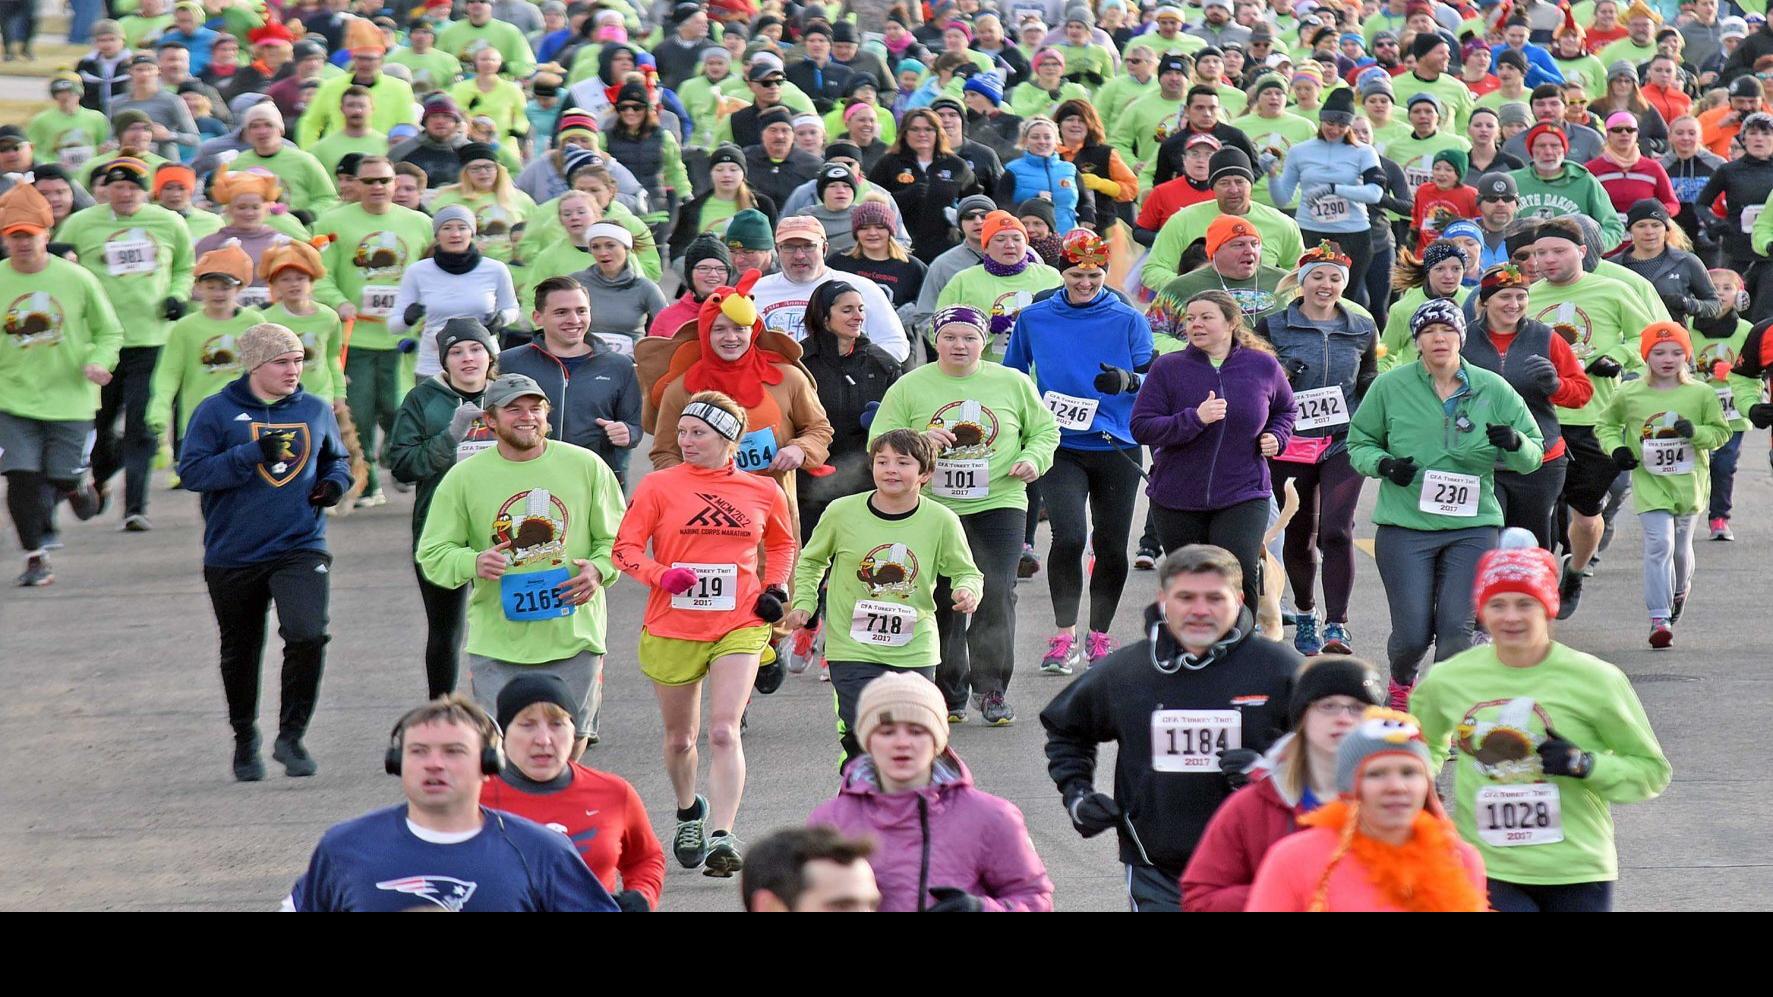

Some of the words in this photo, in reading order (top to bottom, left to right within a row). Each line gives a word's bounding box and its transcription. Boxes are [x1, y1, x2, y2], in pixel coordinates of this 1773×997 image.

[1316, 201, 1345, 217] 1290
[1050, 400, 1089, 422] 1246
[1298, 397, 1341, 420] 1242
[1313, 416, 1330, 425] 2017
[737, 446, 772, 468] 064
[1655, 447, 1684, 466] 394
[944, 471, 976, 488] 101
[1434, 484, 1468, 505] 230
[680, 528, 700, 536] MARINE
[513, 587, 564, 613] 2165
[867, 612, 902, 635] 718
[872, 634, 891, 642] 2017
[1166, 728, 1229, 756] 1184
[1185, 758, 1211, 767] 2017
[1487, 801, 1550, 830] 1028
[1506, 832, 1534, 841] 2017
